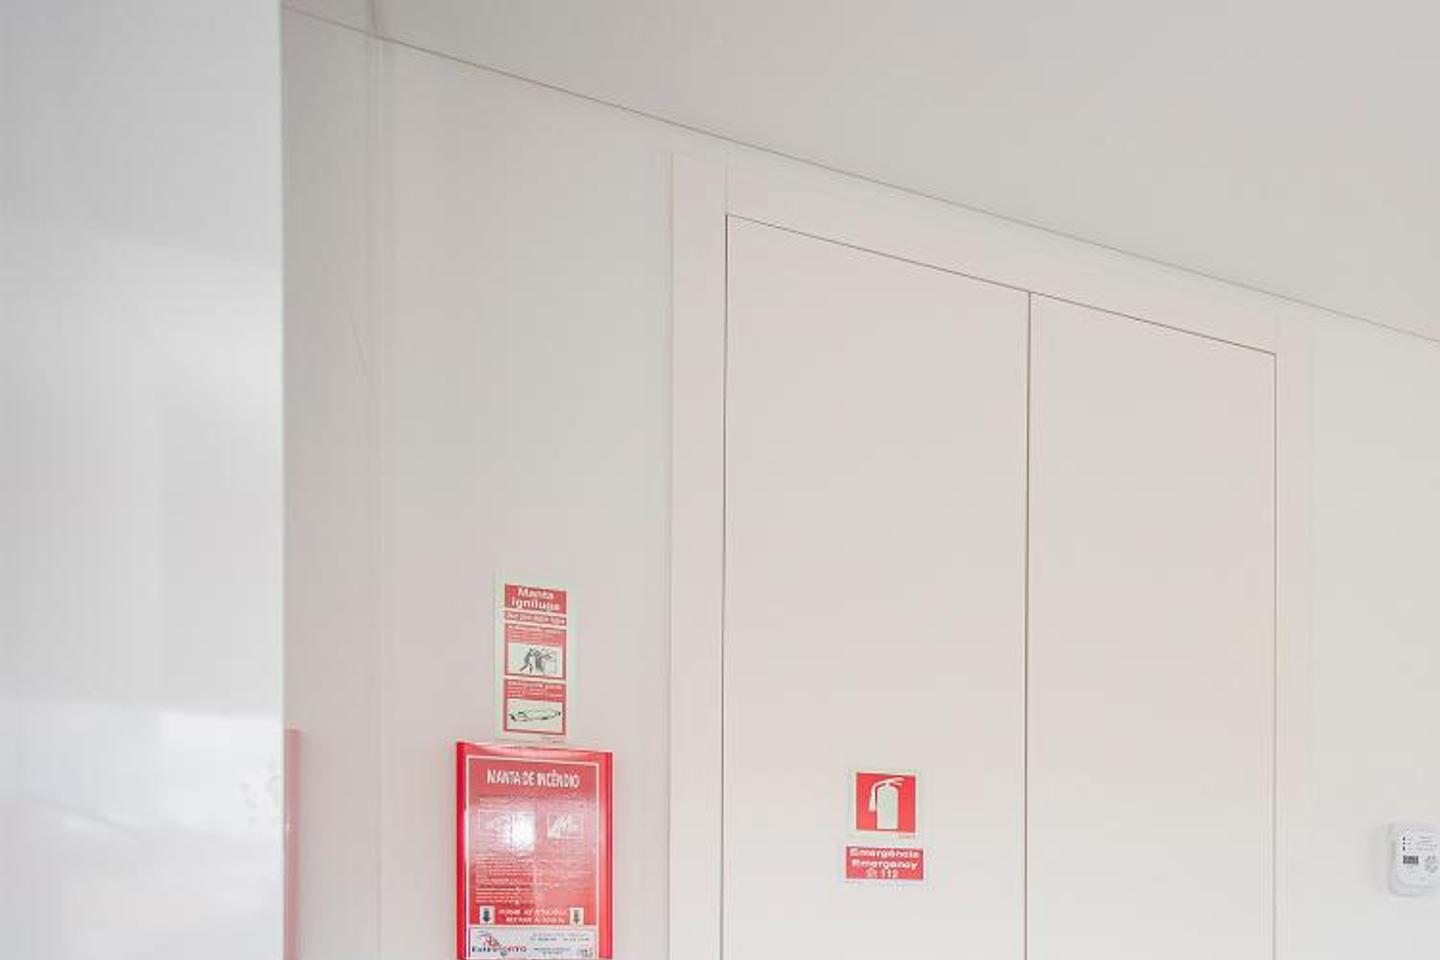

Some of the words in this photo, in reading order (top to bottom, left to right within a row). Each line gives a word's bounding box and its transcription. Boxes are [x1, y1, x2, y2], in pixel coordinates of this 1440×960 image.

[486, 767, 521, 785] MANTA
[521, 770, 535, 787] DE
[851, 858, 918, 870] Emergency
